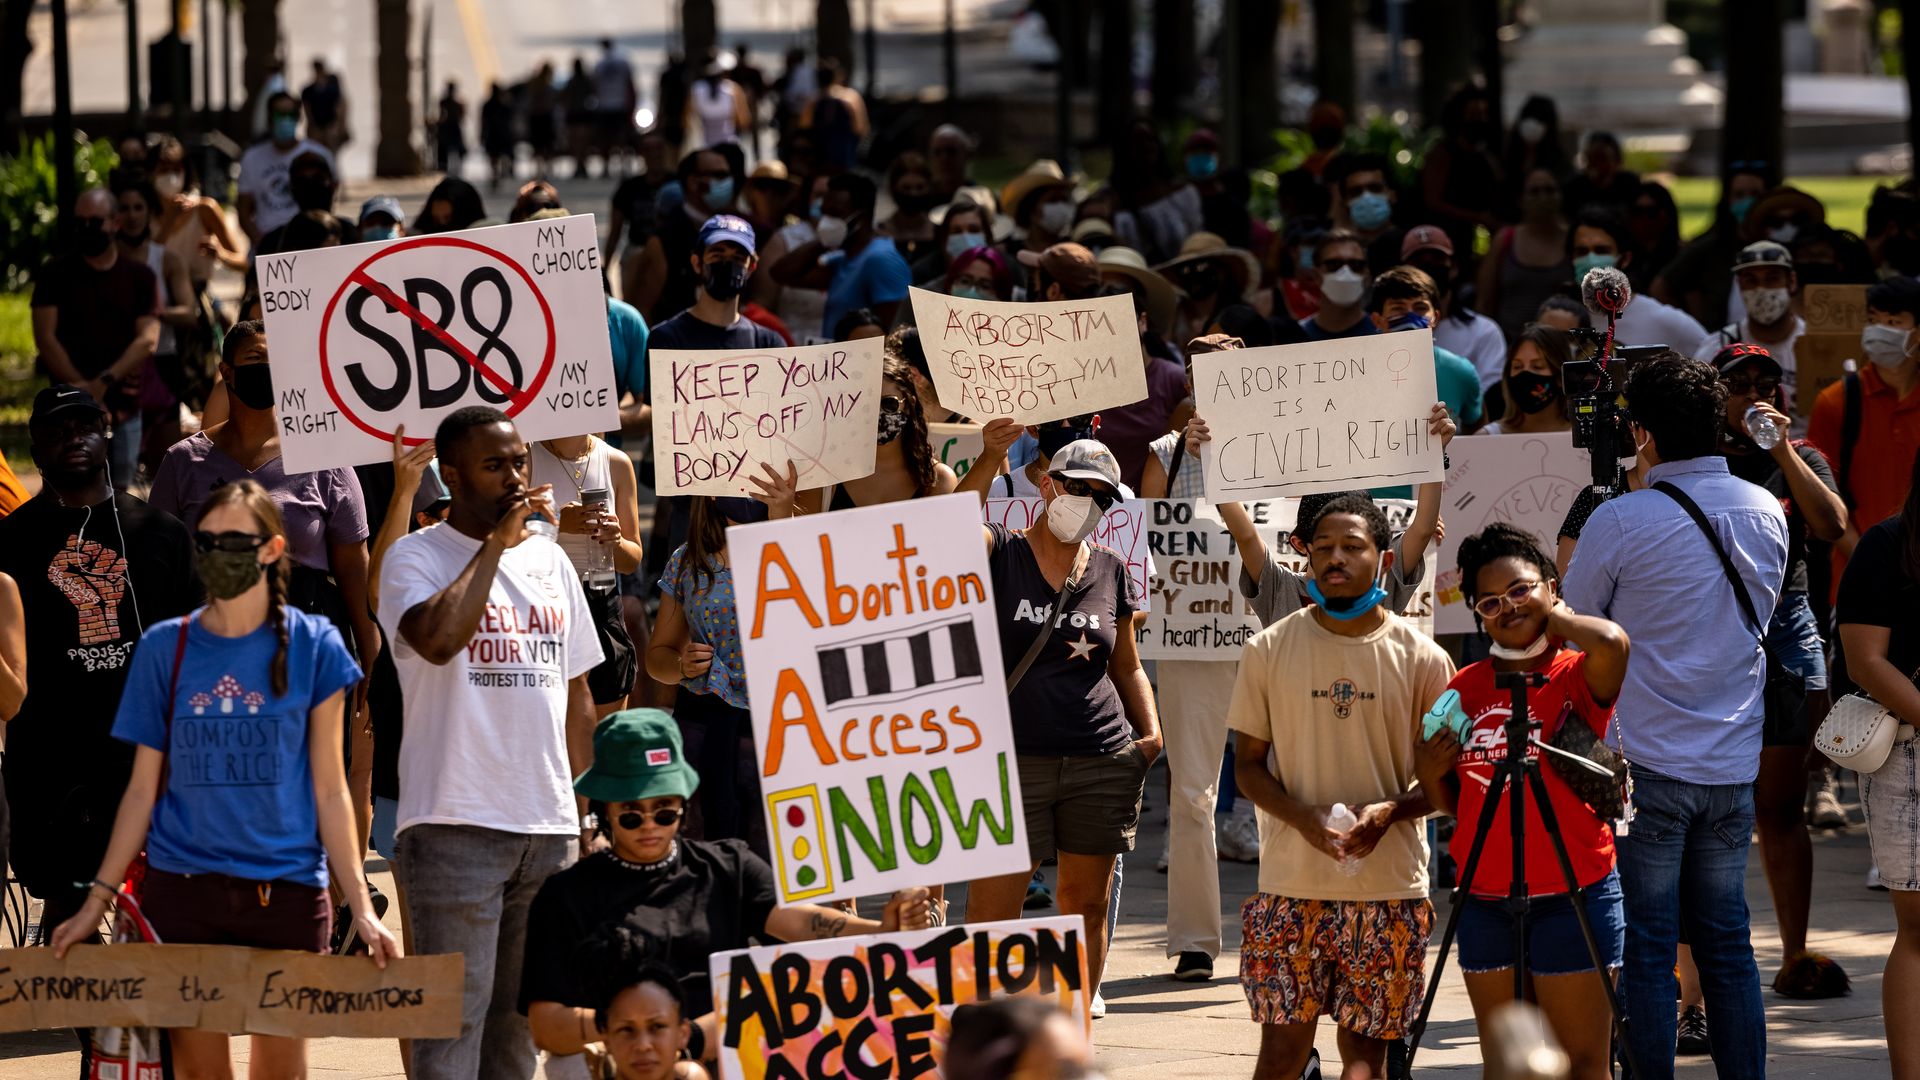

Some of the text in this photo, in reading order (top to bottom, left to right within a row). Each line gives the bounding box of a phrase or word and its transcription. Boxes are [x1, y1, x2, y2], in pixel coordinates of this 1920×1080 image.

[537, 225, 566, 248] MY
[266, 255, 297, 287] MY
[532, 247, 598, 275] CHOICE
[263, 288, 311, 313] BODY
[344, 266, 523, 412] SB8
[560, 360, 588, 387] MY
[671, 350, 849, 404] KEEP YOUR
[951, 350, 1056, 381] GREG
[1213, 357, 1365, 403] ABORTION
[281, 388, 307, 412] MY
[546, 388, 608, 412] VOICE
[961, 375, 1086, 414] ABBOTT
[1273, 397, 1336, 417] IS A
[282, 410, 338, 436] RIGHT
[671, 390, 862, 446] LAWS OFF MY
[1219, 418, 1432, 483] CIVIL RIGHT
[672, 449, 749, 488] BODY
[1153, 501, 1192, 525] DO
[750, 523, 986, 640] Abortion
[1170, 559, 1230, 586] GUN
[1188, 589, 1233, 615] and
[67, 641, 134, 660] PROJECT
[84, 655, 126, 672] BABY
[466, 639, 523, 663] YOUR
[468, 672, 519, 687] PROTEST
[522, 673, 536, 687] TO
[175, 719, 282, 749] COMPOST
[763, 668, 982, 777] Access
[181, 752, 282, 781] THE RICH
[827, 751, 1014, 882] NOW
[178, 975, 224, 1002] the
[724, 927, 1082, 1050] ABORTION
